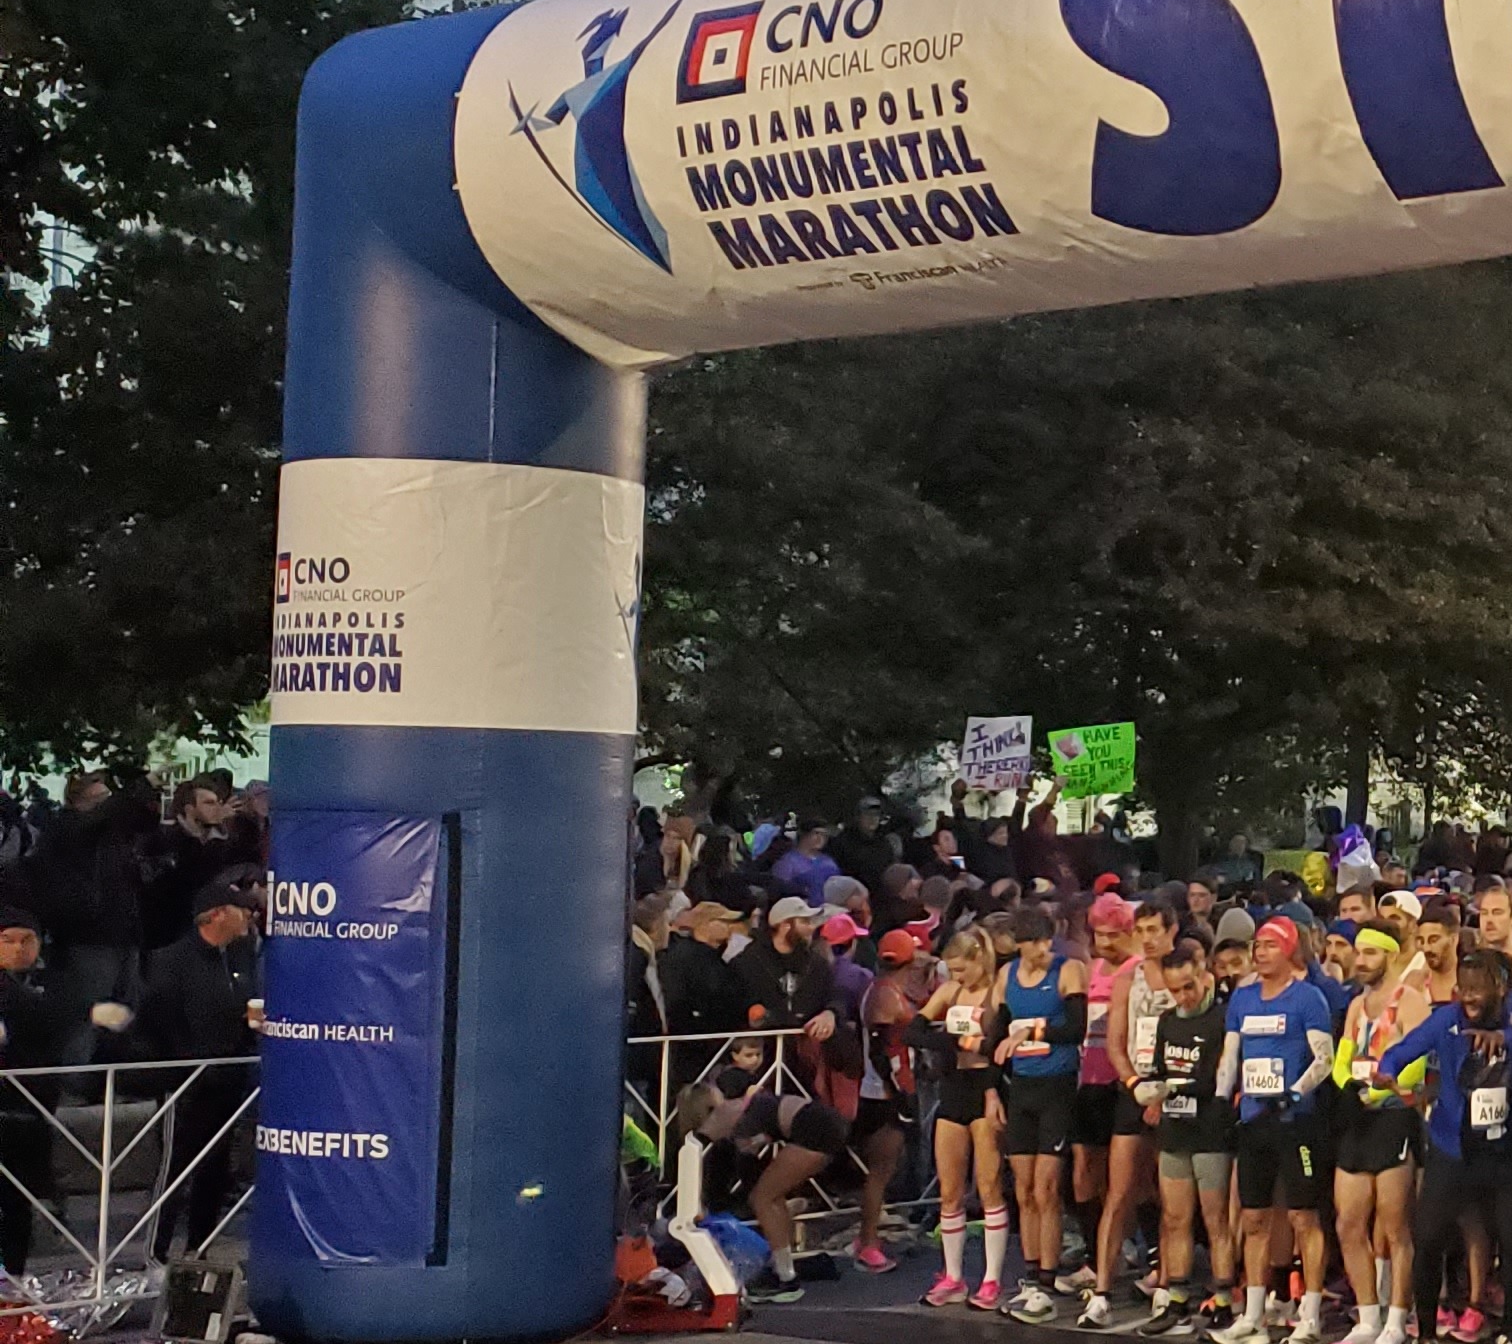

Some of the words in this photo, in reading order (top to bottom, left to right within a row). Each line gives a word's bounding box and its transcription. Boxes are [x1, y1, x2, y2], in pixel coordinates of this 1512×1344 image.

[760, 48, 875, 91] FINANCIAL
[881, 32, 963, 69] GROUP
[676, 79, 969, 157] INDIANAPOLIS
[685, 125, 986, 212] MONUMENTAL
[707, 183, 1020, 270] MARATHON
[875, 263, 959, 284] Franciscan
[294, 557, 350, 584] CNO
[293, 589, 348, 602] FINANCIAL
[352, 589, 405, 602] GROUP
[1083, 726, 1121, 743] HAVE
[1086, 744, 1111, 760] YOU
[276, 882, 337, 916] CNO
[274, 920, 333, 938] FINANCIAL
[336, 923, 399, 940] GROUP
[324, 1025, 393, 1042] HEALTH
